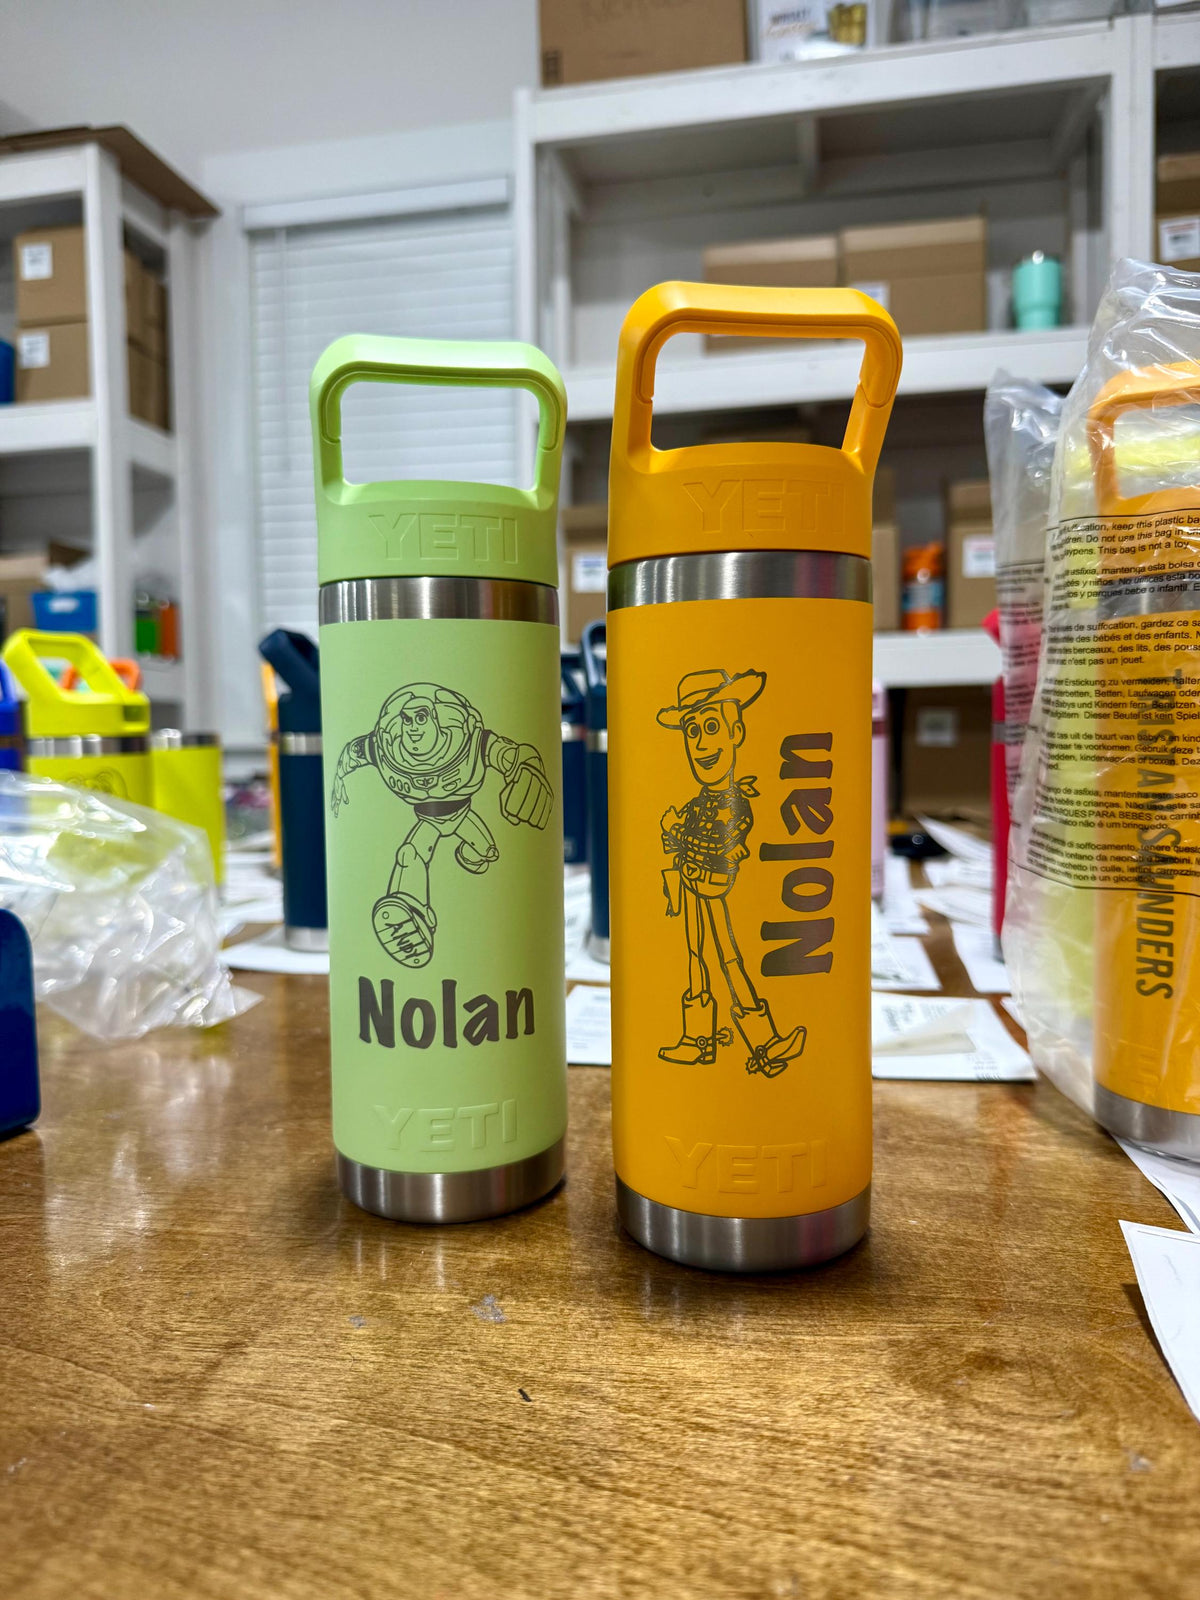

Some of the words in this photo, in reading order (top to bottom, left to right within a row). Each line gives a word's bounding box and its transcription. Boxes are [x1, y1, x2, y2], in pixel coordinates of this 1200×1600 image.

[683, 479, 847, 535] YETI
[1112, 521, 1134, 532] keep
[1136, 519, 1152, 529] this
[1154, 516, 1184, 527] plastic
[368, 512, 519, 565] YETI
[1086, 534, 1099, 543] Do
[1101, 534, 1115, 542] not
[1137, 530, 1152, 540] this
[1155, 528, 1172, 538] bag
[1119, 545, 1136, 556] bag
[1138, 543, 1146, 552] is
[1148, 541, 1162, 551] not
[1165, 541, 1171, 549] a
[1147, 562, 1165, 571] esta
[1168, 560, 1194, 569] bolsa
[1166, 572, 1185, 581] esta
[1074, 624, 1085, 632] de
[1140, 619, 1174, 631] gardez
[1076, 634, 1091, 643] des
[1123, 633, 1133, 641] et
[1134, 631, 1151, 641] des
[1153, 629, 1193, 640] enfants.
[1117, 644, 1133, 653] des
[1153, 642, 1171, 651] des
[1088, 657, 1104, 667] pas
[1106, 657, 1118, 665] un
[1120, 655, 1145, 666] jouet.
[1077, 701, 1093, 709] und
[1084, 711, 1111, 720] Dieser
[1155, 711, 1173, 720] kein
[1134, 744, 1168, 754] Gebruik
[1170, 745, 1194, 755] deze
[1174, 791, 1198, 799] saco
[1088, 809, 1116, 819] PARA
[1106, 821, 1120, 829] um
[759, 731, 835, 977] Nolan
[1136, 828, 1181, 1000] SAUNDERS
[358, 975, 536, 1049] Nolan
[374, 1100, 519, 1152] YETI
[664, 1135, 828, 1196] YETI
